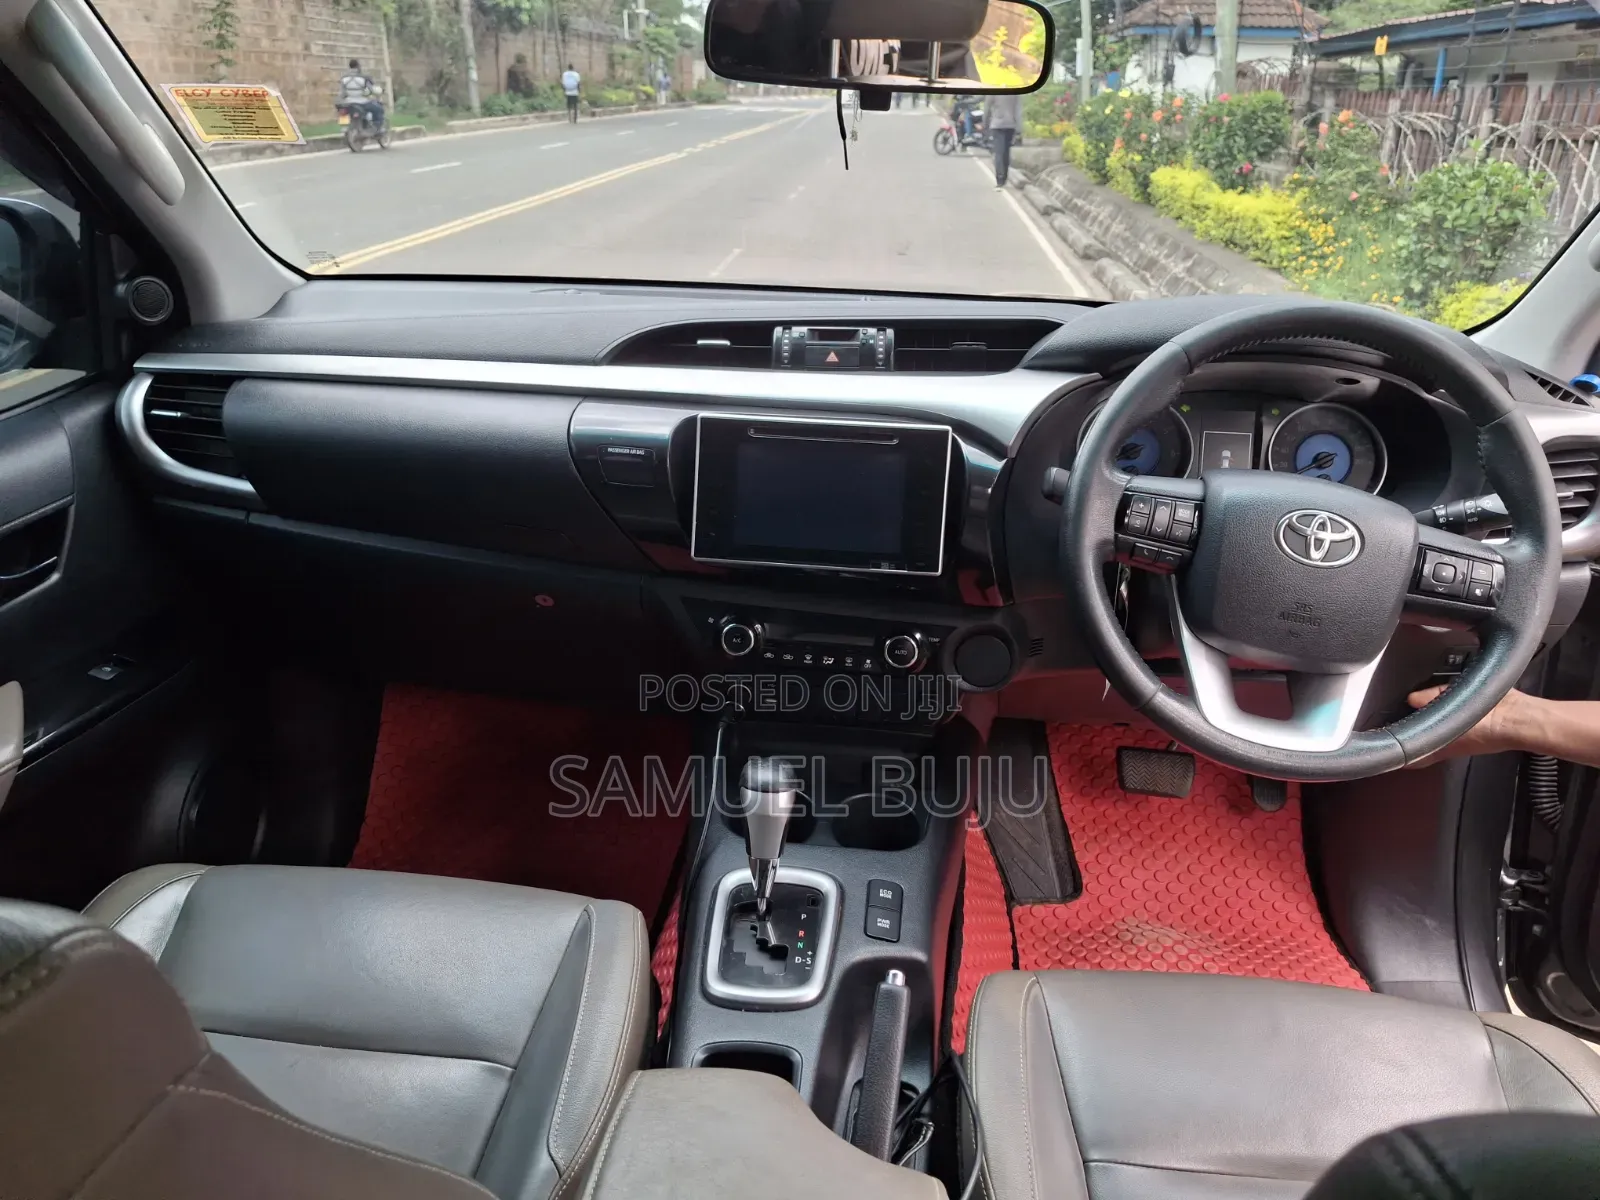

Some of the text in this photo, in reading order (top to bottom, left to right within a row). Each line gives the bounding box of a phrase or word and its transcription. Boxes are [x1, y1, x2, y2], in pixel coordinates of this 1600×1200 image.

[175, 89, 211, 97] ELCY
[798, 930, 805, 938] R
[797, 941, 804, 949] N
